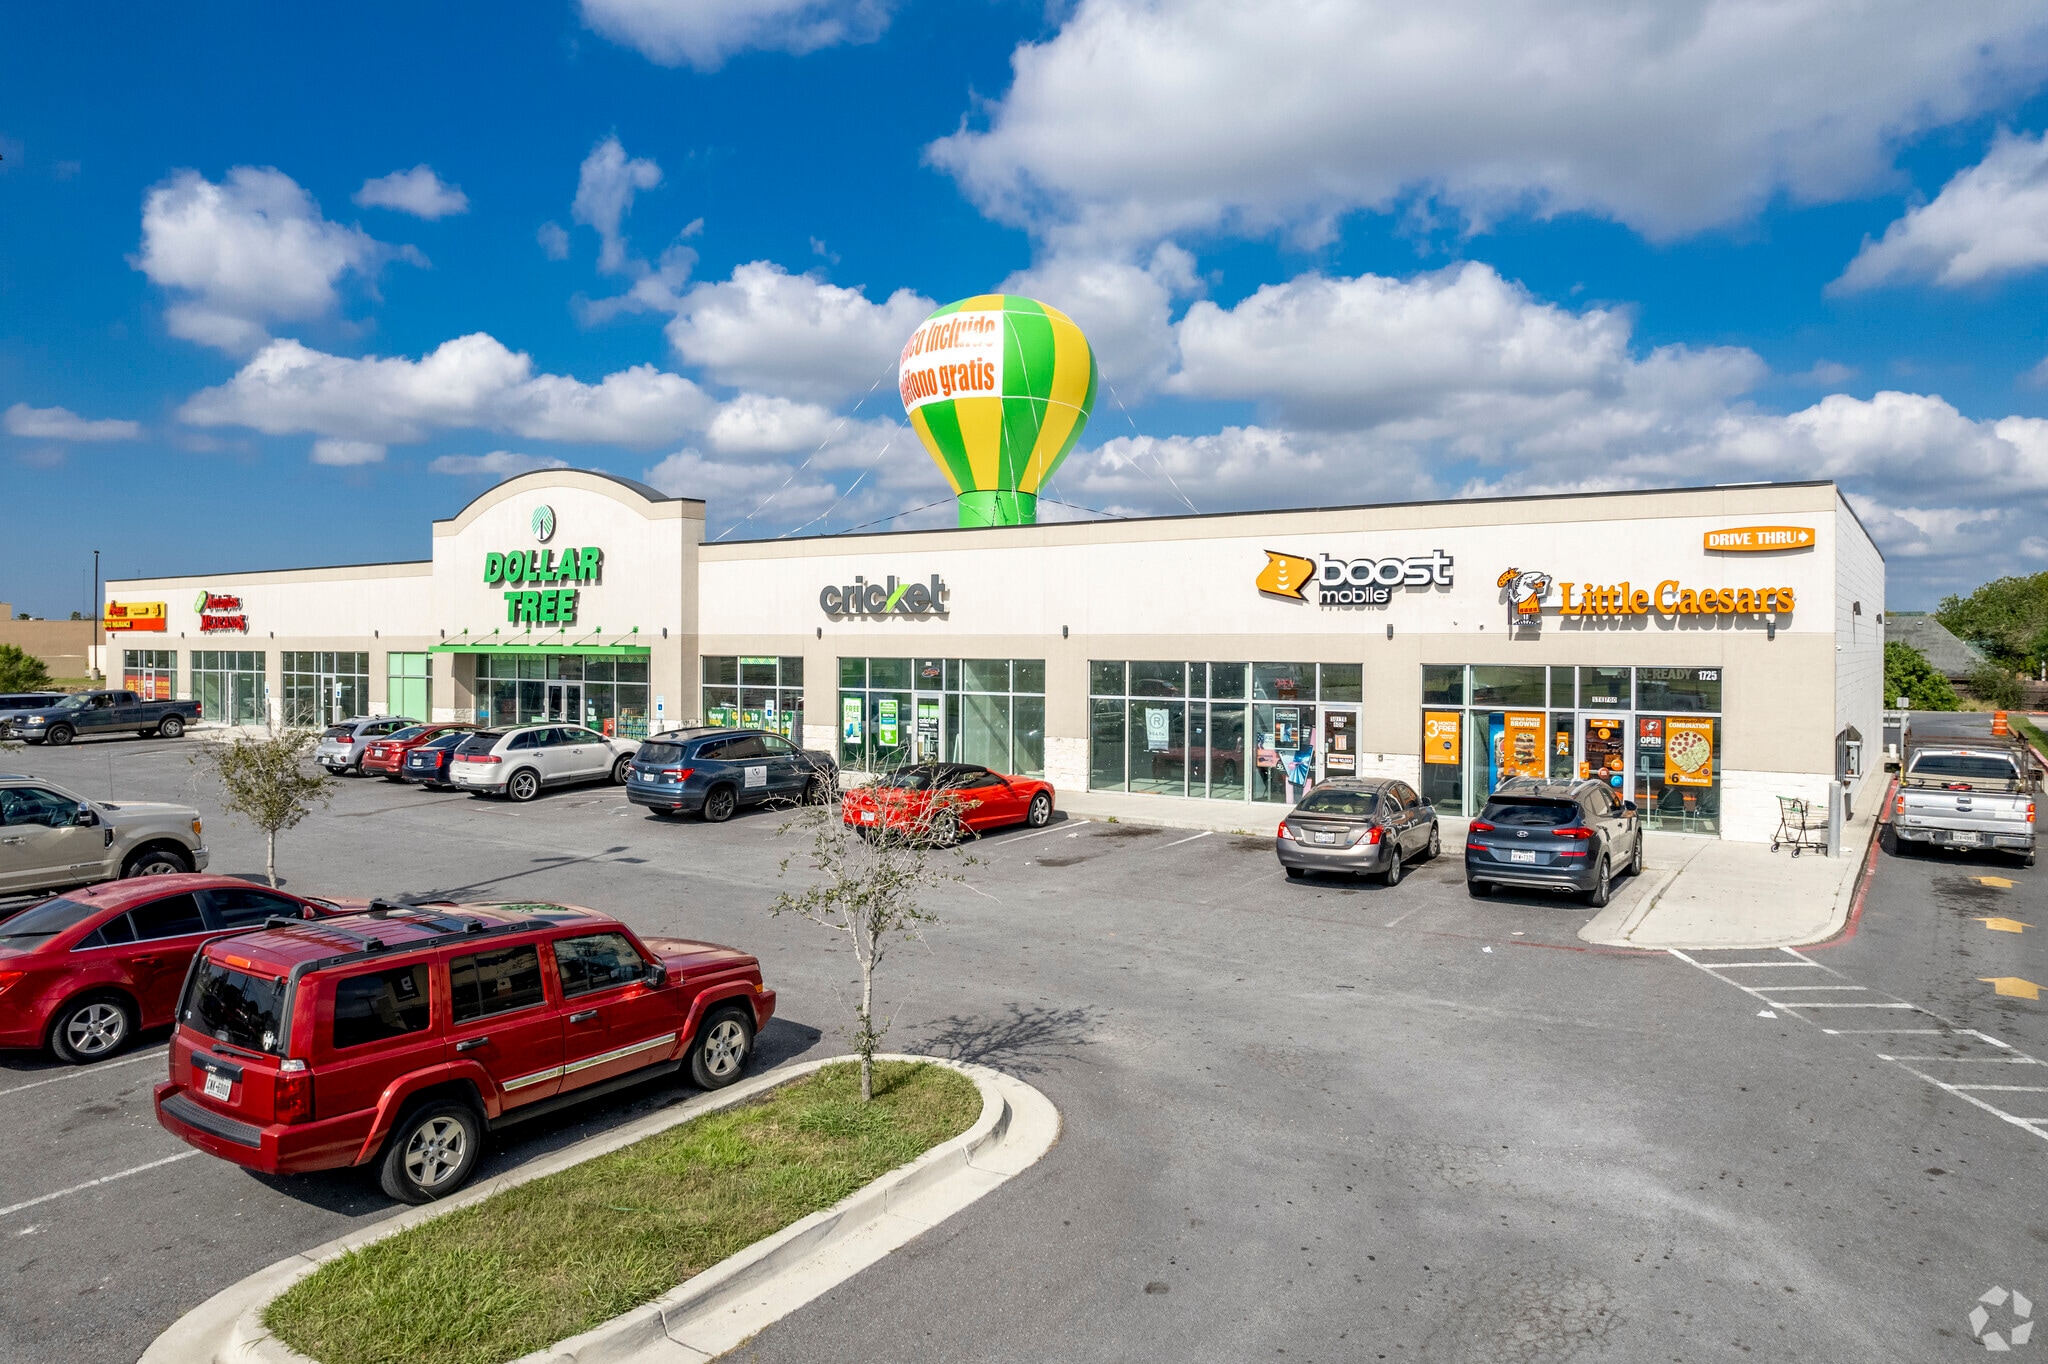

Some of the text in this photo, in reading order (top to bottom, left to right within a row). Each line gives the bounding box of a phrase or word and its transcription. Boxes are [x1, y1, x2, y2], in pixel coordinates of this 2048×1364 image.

[939, 357, 995, 397] gratis
[1709, 531, 1797, 547] DRIVE THRU
[484, 547, 601, 583] DOLLAR
[1319, 550, 1450, 586] boost
[820, 574, 946, 614] cricket
[1319, 587, 1388, 604] mobile
[1559, 580, 1795, 615] Little Caesars
[504, 589, 575, 622] TREE
[1274, 678, 1295, 688] OPEN
[1698, 670, 1718, 681] 1725
[845, 705, 860, 713] FREE
[1427, 719, 1439, 738] 3
[1438, 725, 1457, 733] FREE
[1510, 720, 1541, 728] BROWNIE
[1640, 736, 1662, 746] OPEN
